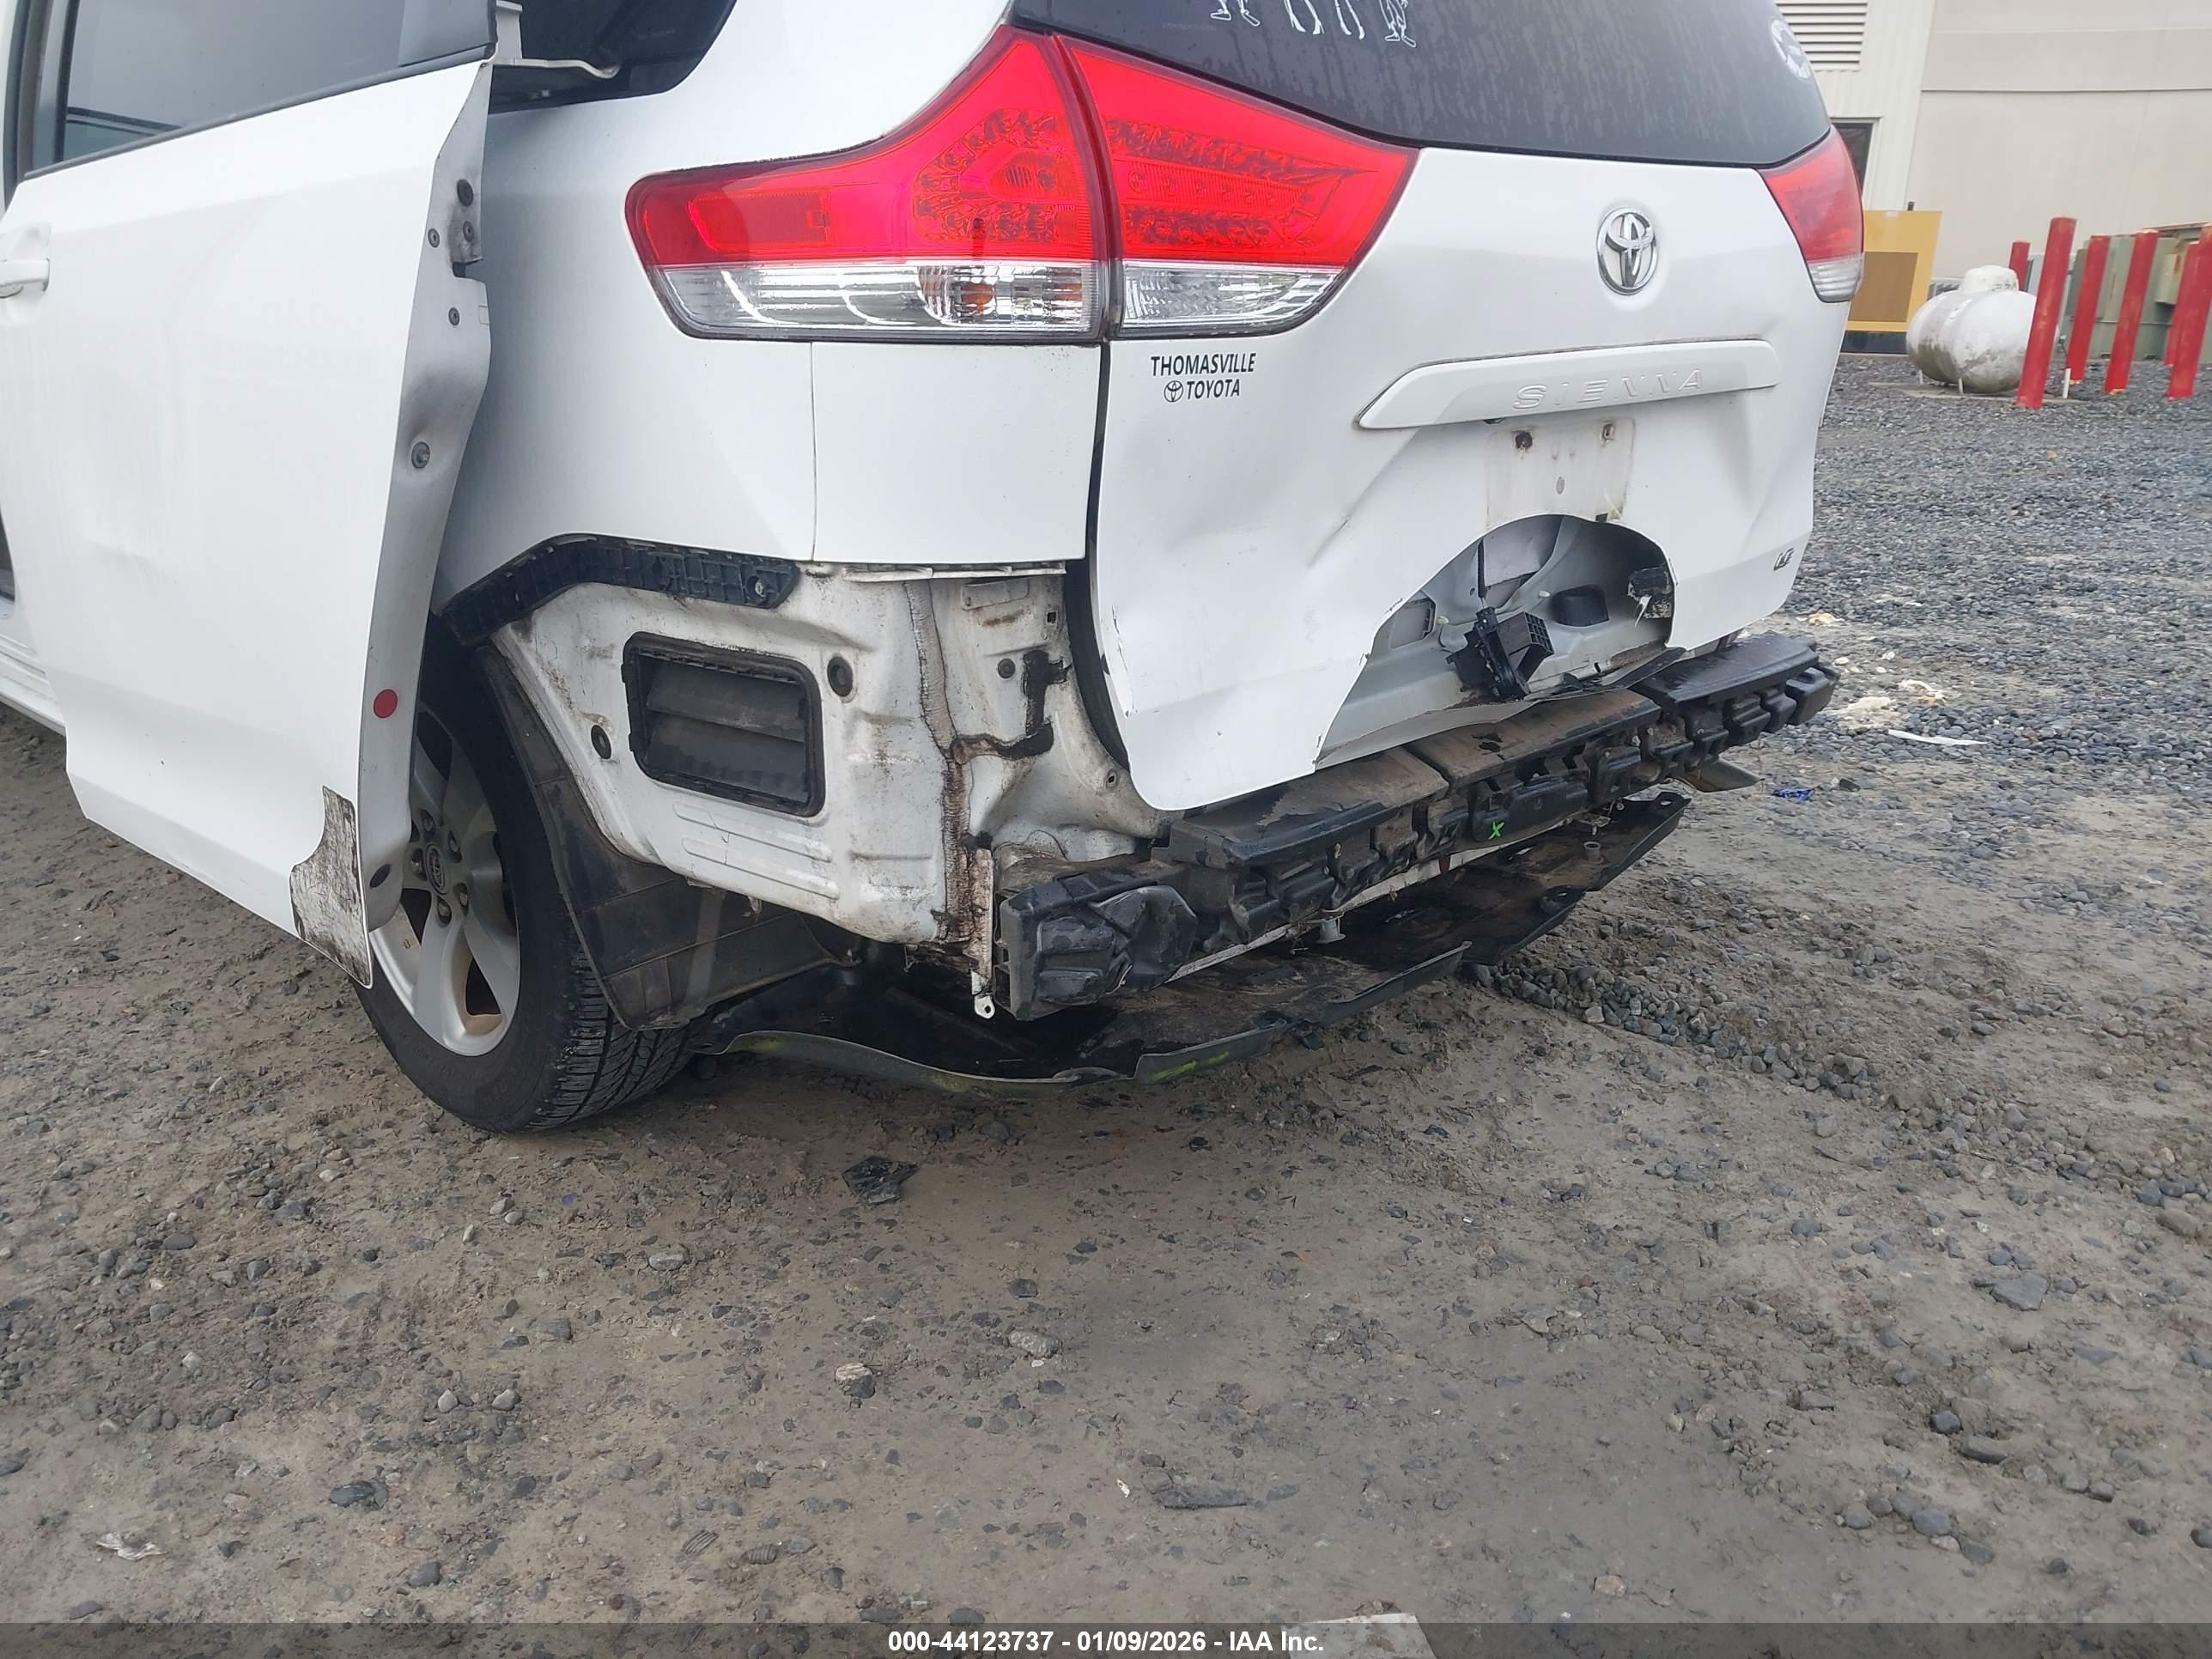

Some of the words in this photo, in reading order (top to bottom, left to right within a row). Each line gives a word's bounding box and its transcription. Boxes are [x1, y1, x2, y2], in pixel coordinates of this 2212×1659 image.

[1151, 353, 1256, 376] THOMASVILLE
[1187, 378, 1240, 399] TOYOTA
[1513, 368, 1702, 410] SIENNA
[1773, 547, 1795, 571] LE
